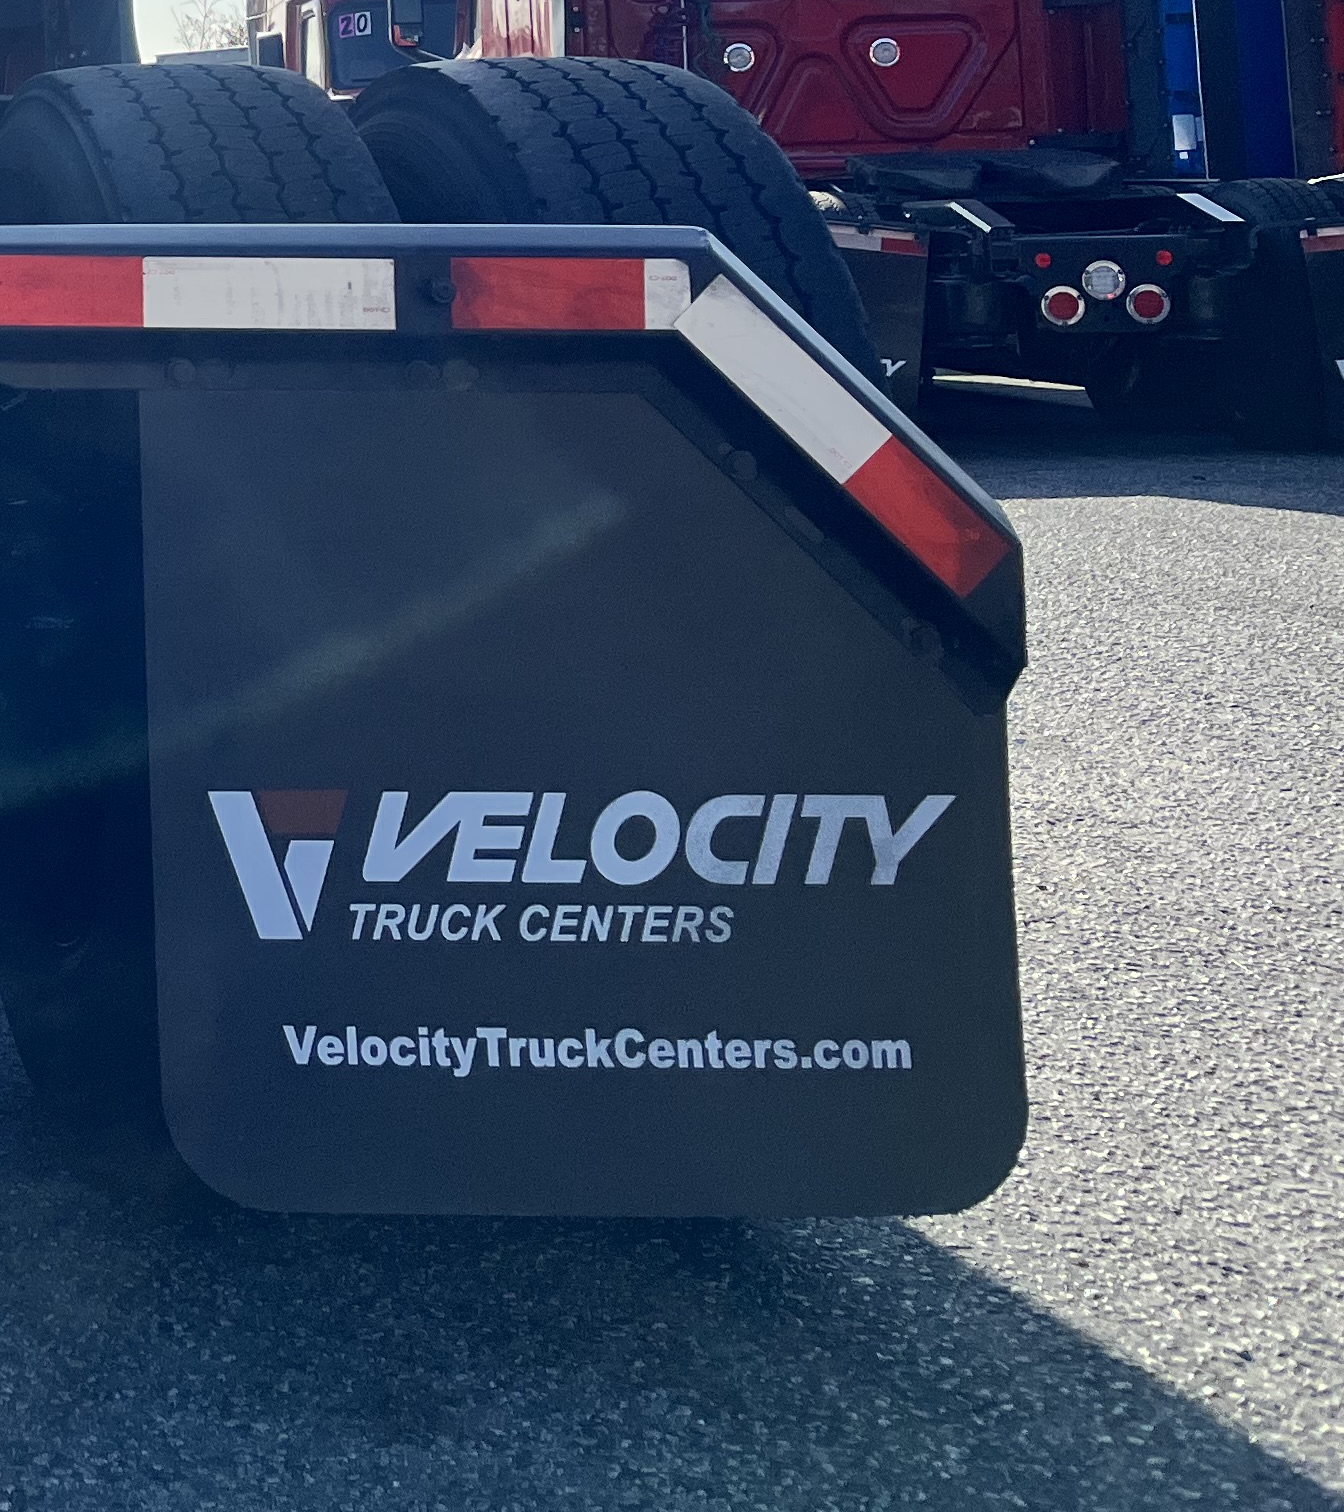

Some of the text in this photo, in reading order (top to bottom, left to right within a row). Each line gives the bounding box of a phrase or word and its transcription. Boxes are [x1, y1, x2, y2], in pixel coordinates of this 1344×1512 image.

[340, 13, 368, 35] 20
[363, 791, 956, 885] VELOCITY
[350, 904, 734, 942] TRUCK CENTERS
[283, 1025, 911, 1077] VelocityTruckCenters.com
